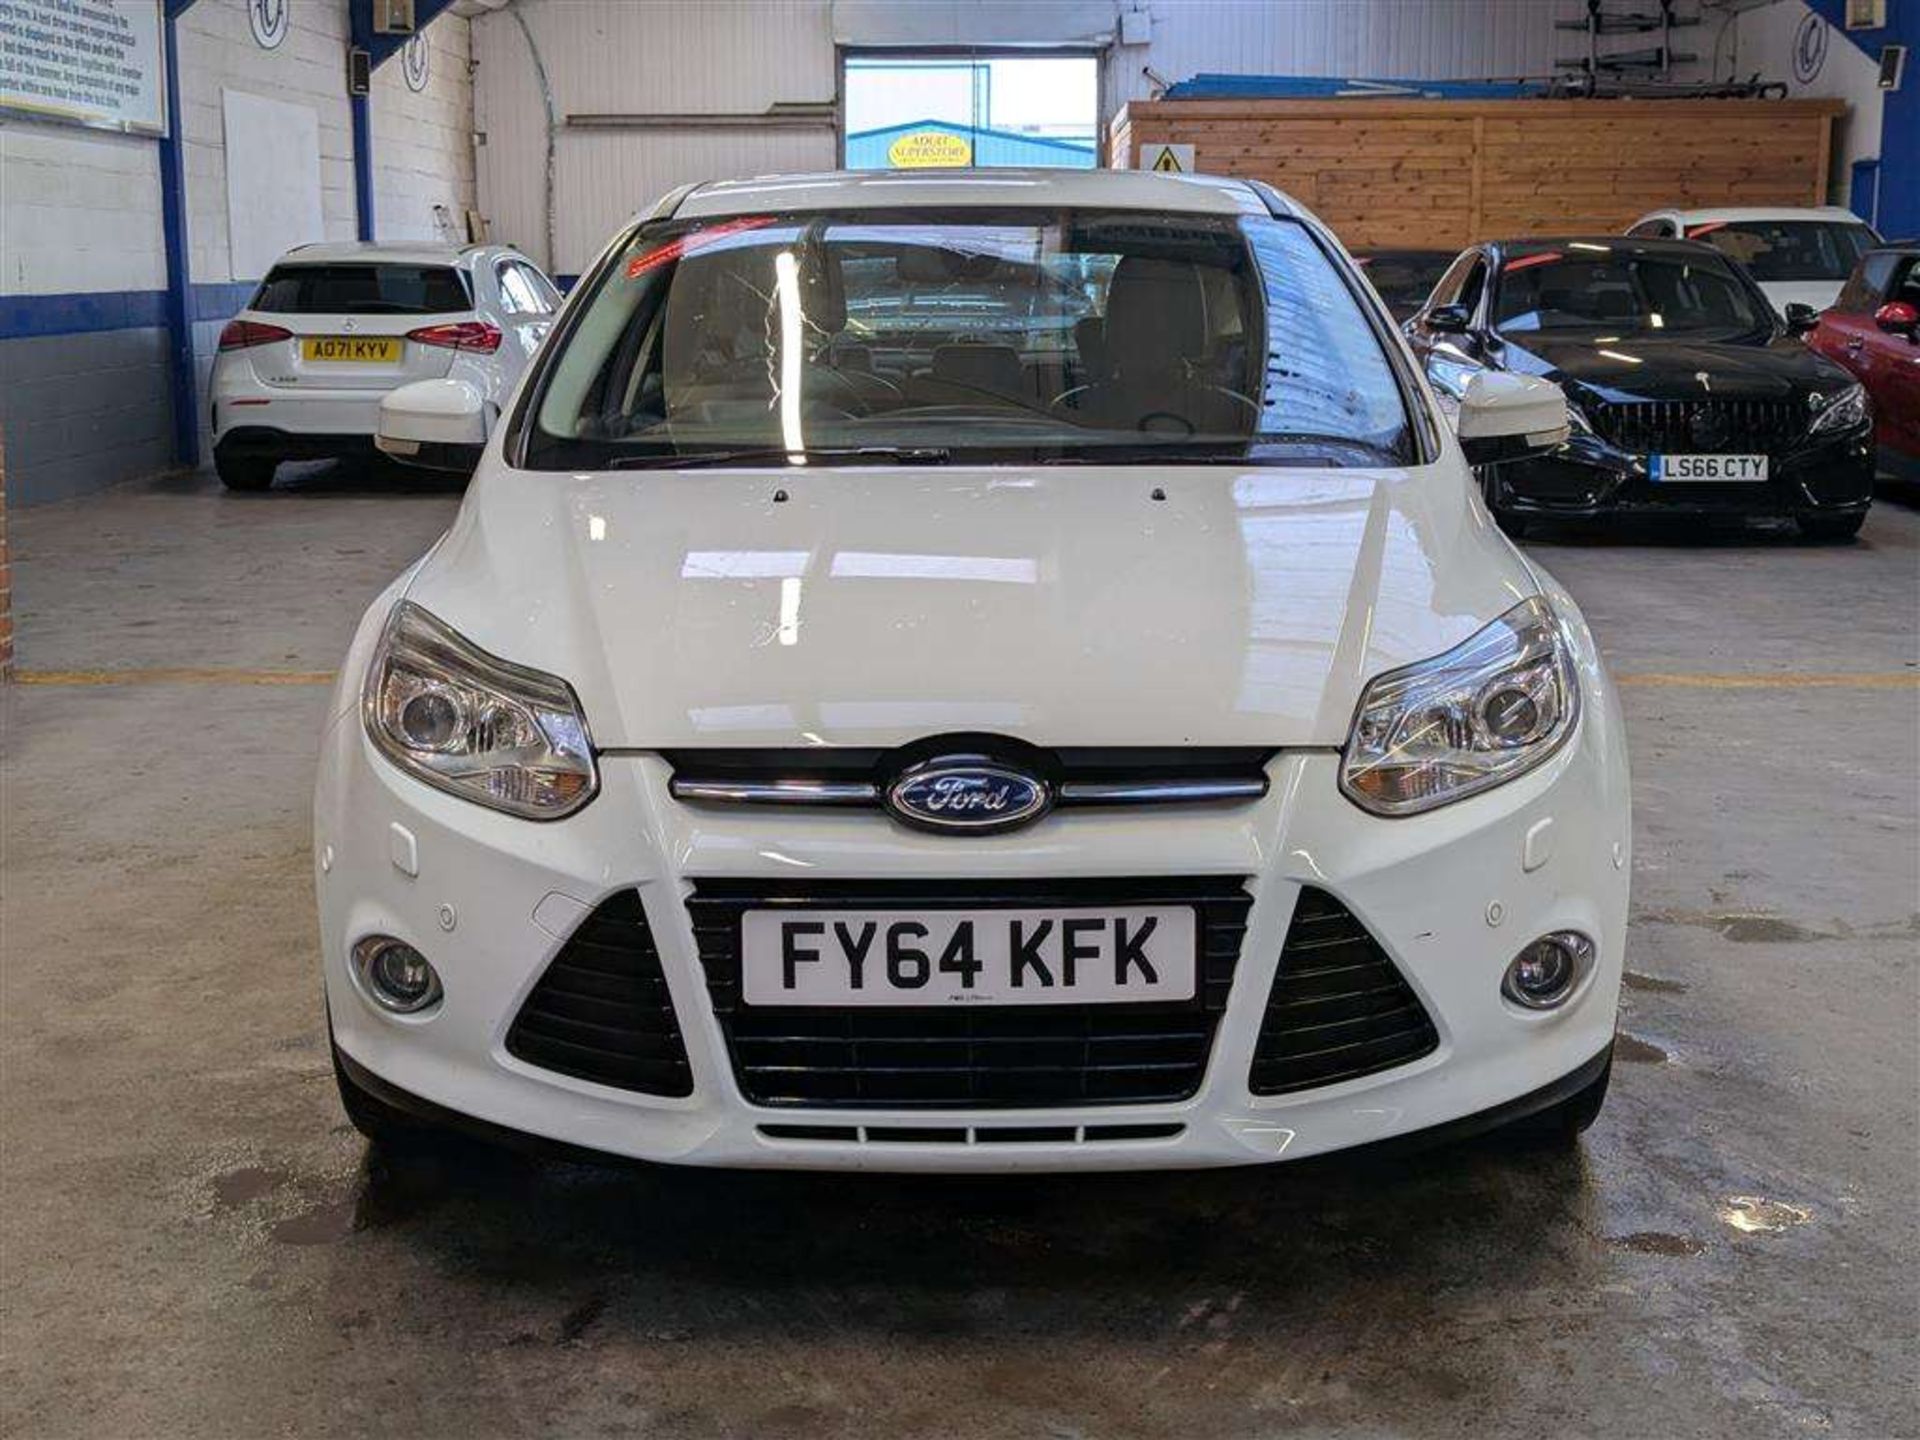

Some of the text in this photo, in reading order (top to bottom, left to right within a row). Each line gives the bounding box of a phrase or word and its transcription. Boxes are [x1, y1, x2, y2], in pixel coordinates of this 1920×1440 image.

[313, 341, 389, 358] AO71 KYV
[1664, 458, 1763, 477] LS66 CTY
[927, 777, 1010, 811] Ford
[781, 916, 1159, 990] FY64 KFK
